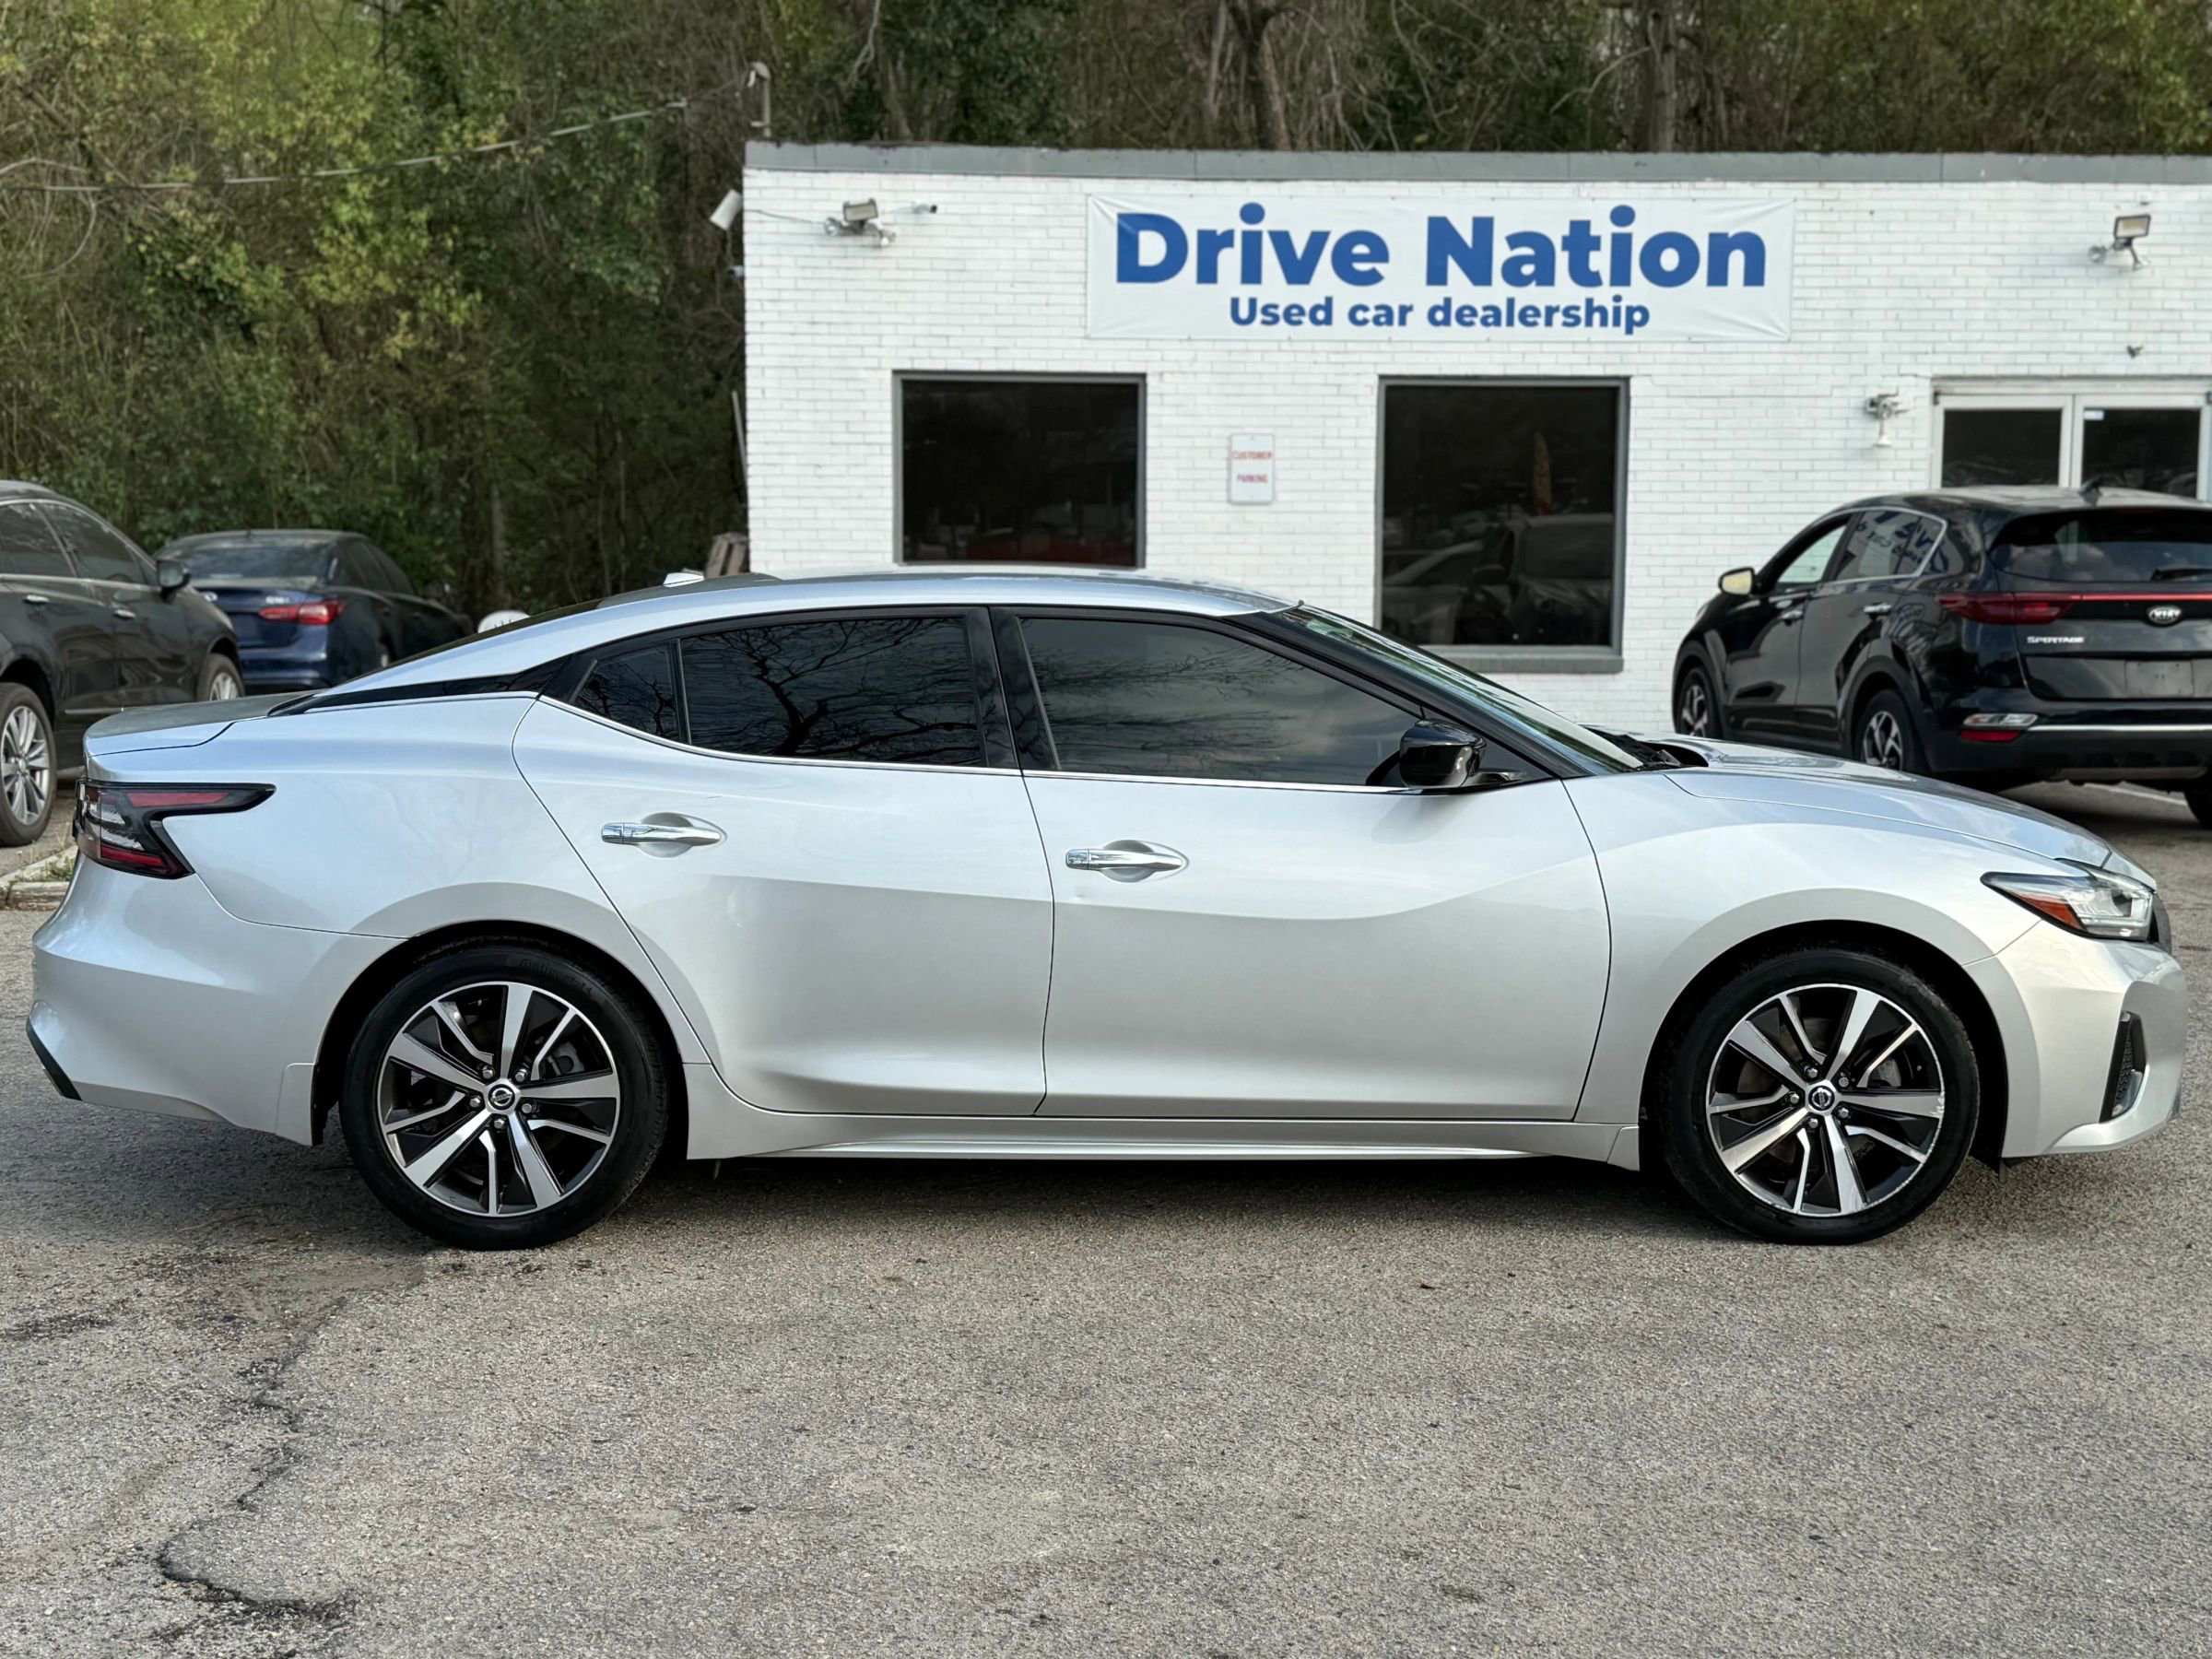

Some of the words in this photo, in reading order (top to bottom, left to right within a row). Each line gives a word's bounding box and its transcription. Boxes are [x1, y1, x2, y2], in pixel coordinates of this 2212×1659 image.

[1116, 202, 1391, 286] Drive
[1426, 206, 1767, 288] Nation
[1230, 297, 1334, 327] Used
[1347, 304, 1413, 327] car
[1427, 295, 1650, 335] dealership
